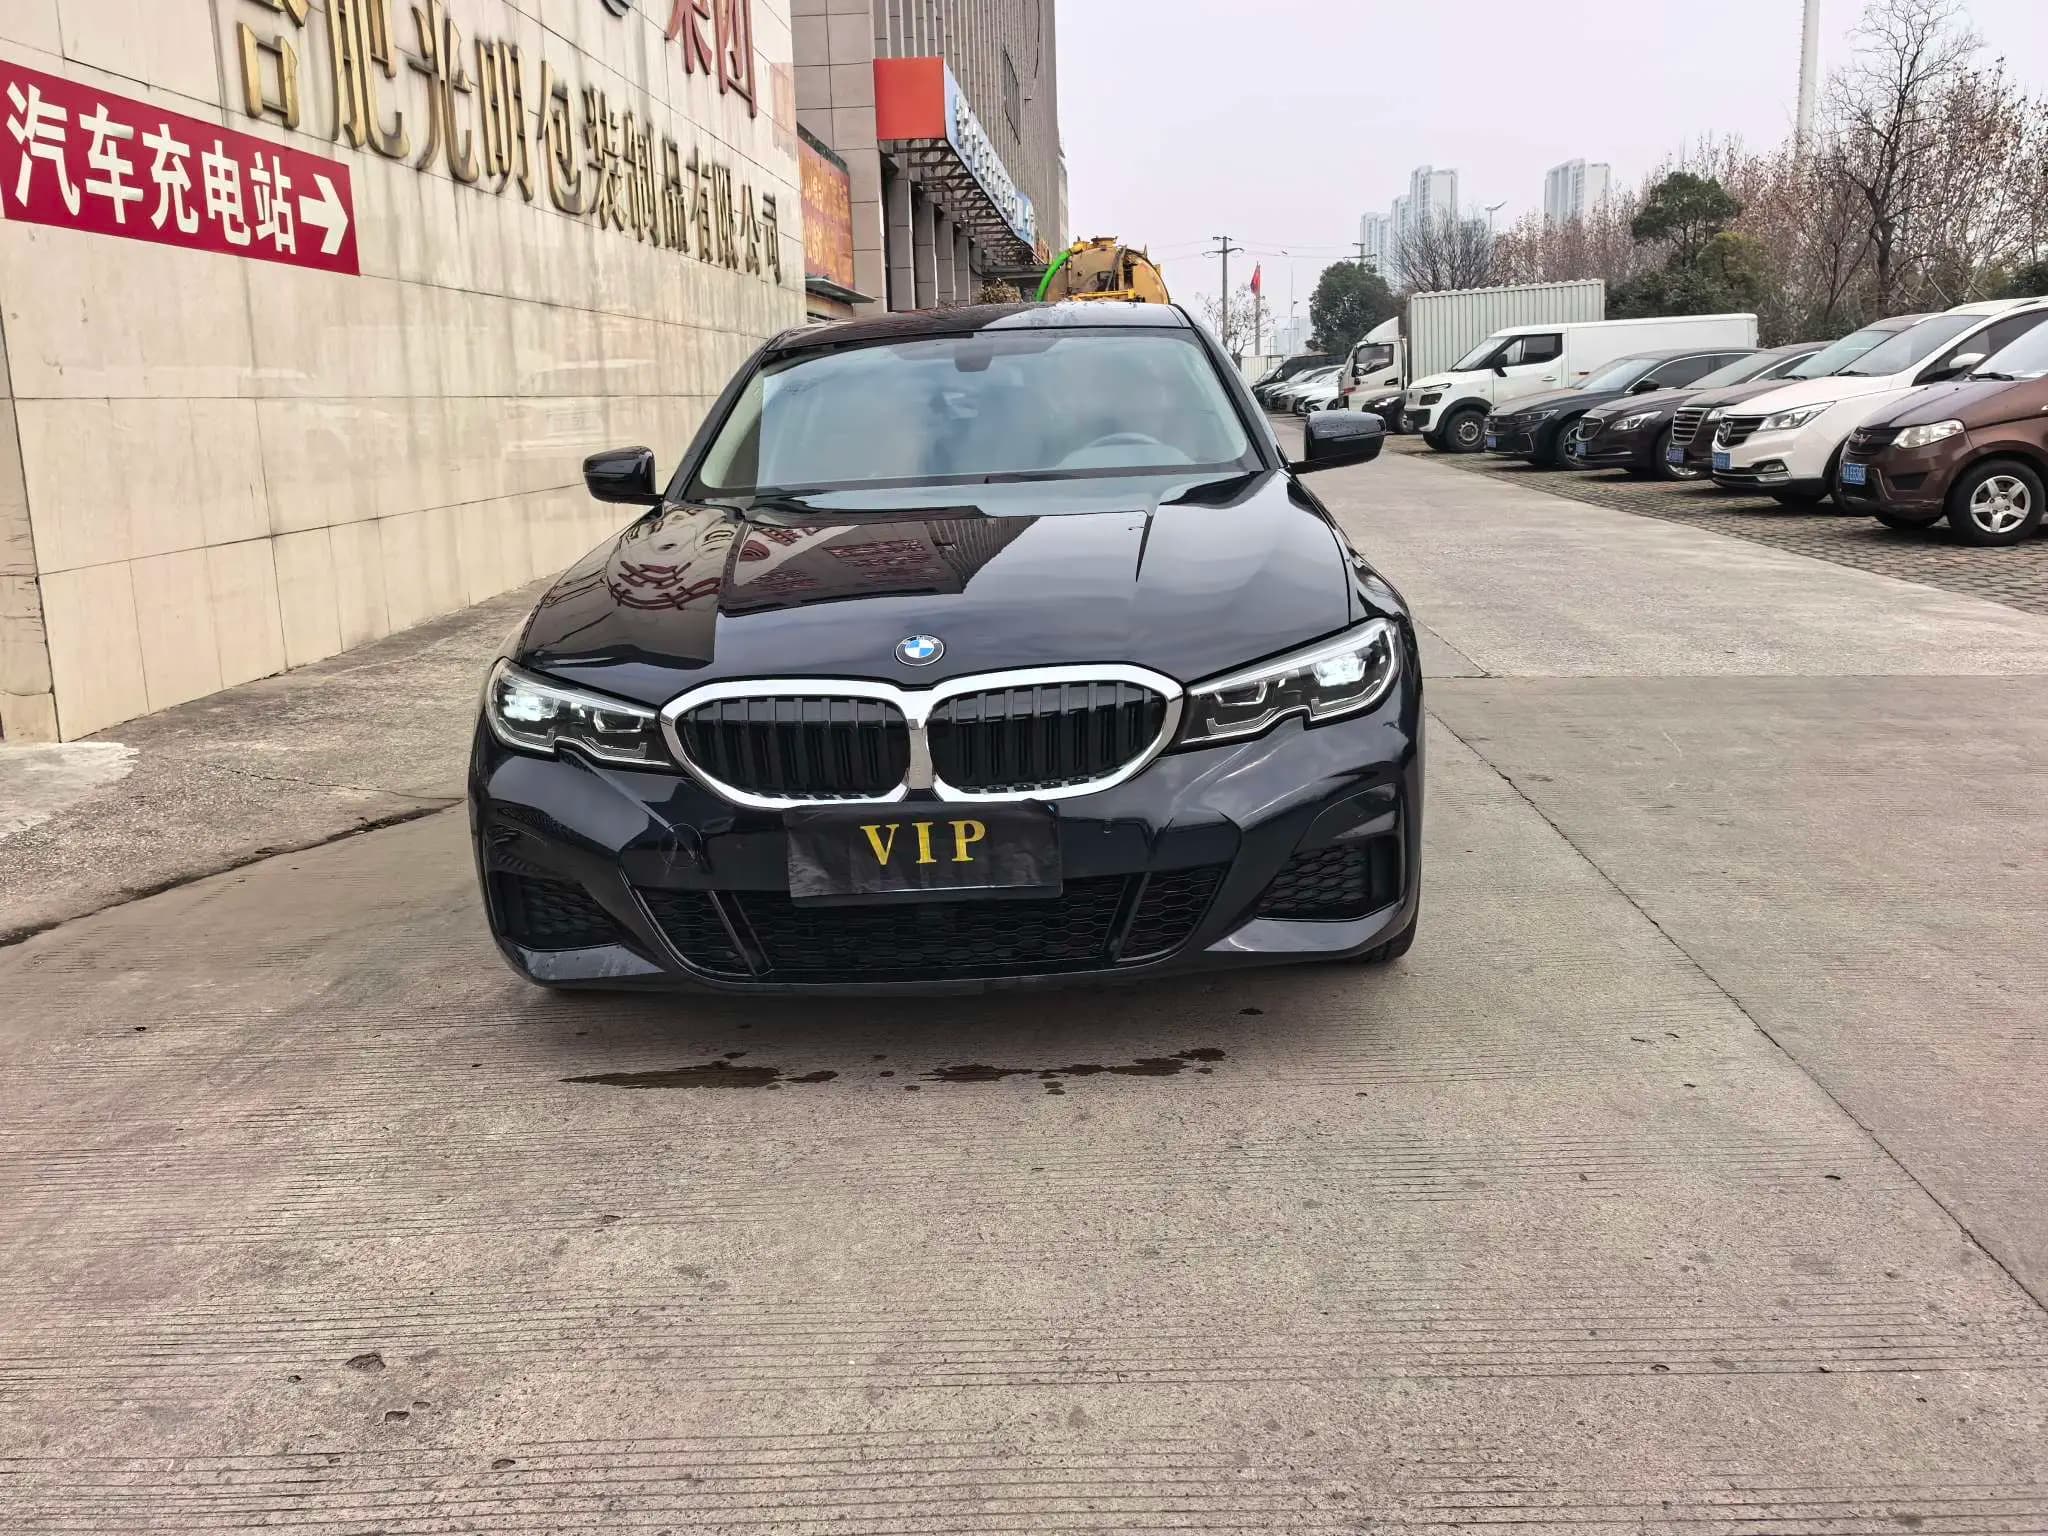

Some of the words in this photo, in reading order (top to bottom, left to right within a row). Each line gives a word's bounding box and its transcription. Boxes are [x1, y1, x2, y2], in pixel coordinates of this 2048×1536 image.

[6, 81, 297, 254] 汽车充电站
[859, 819, 987, 866] VIP
